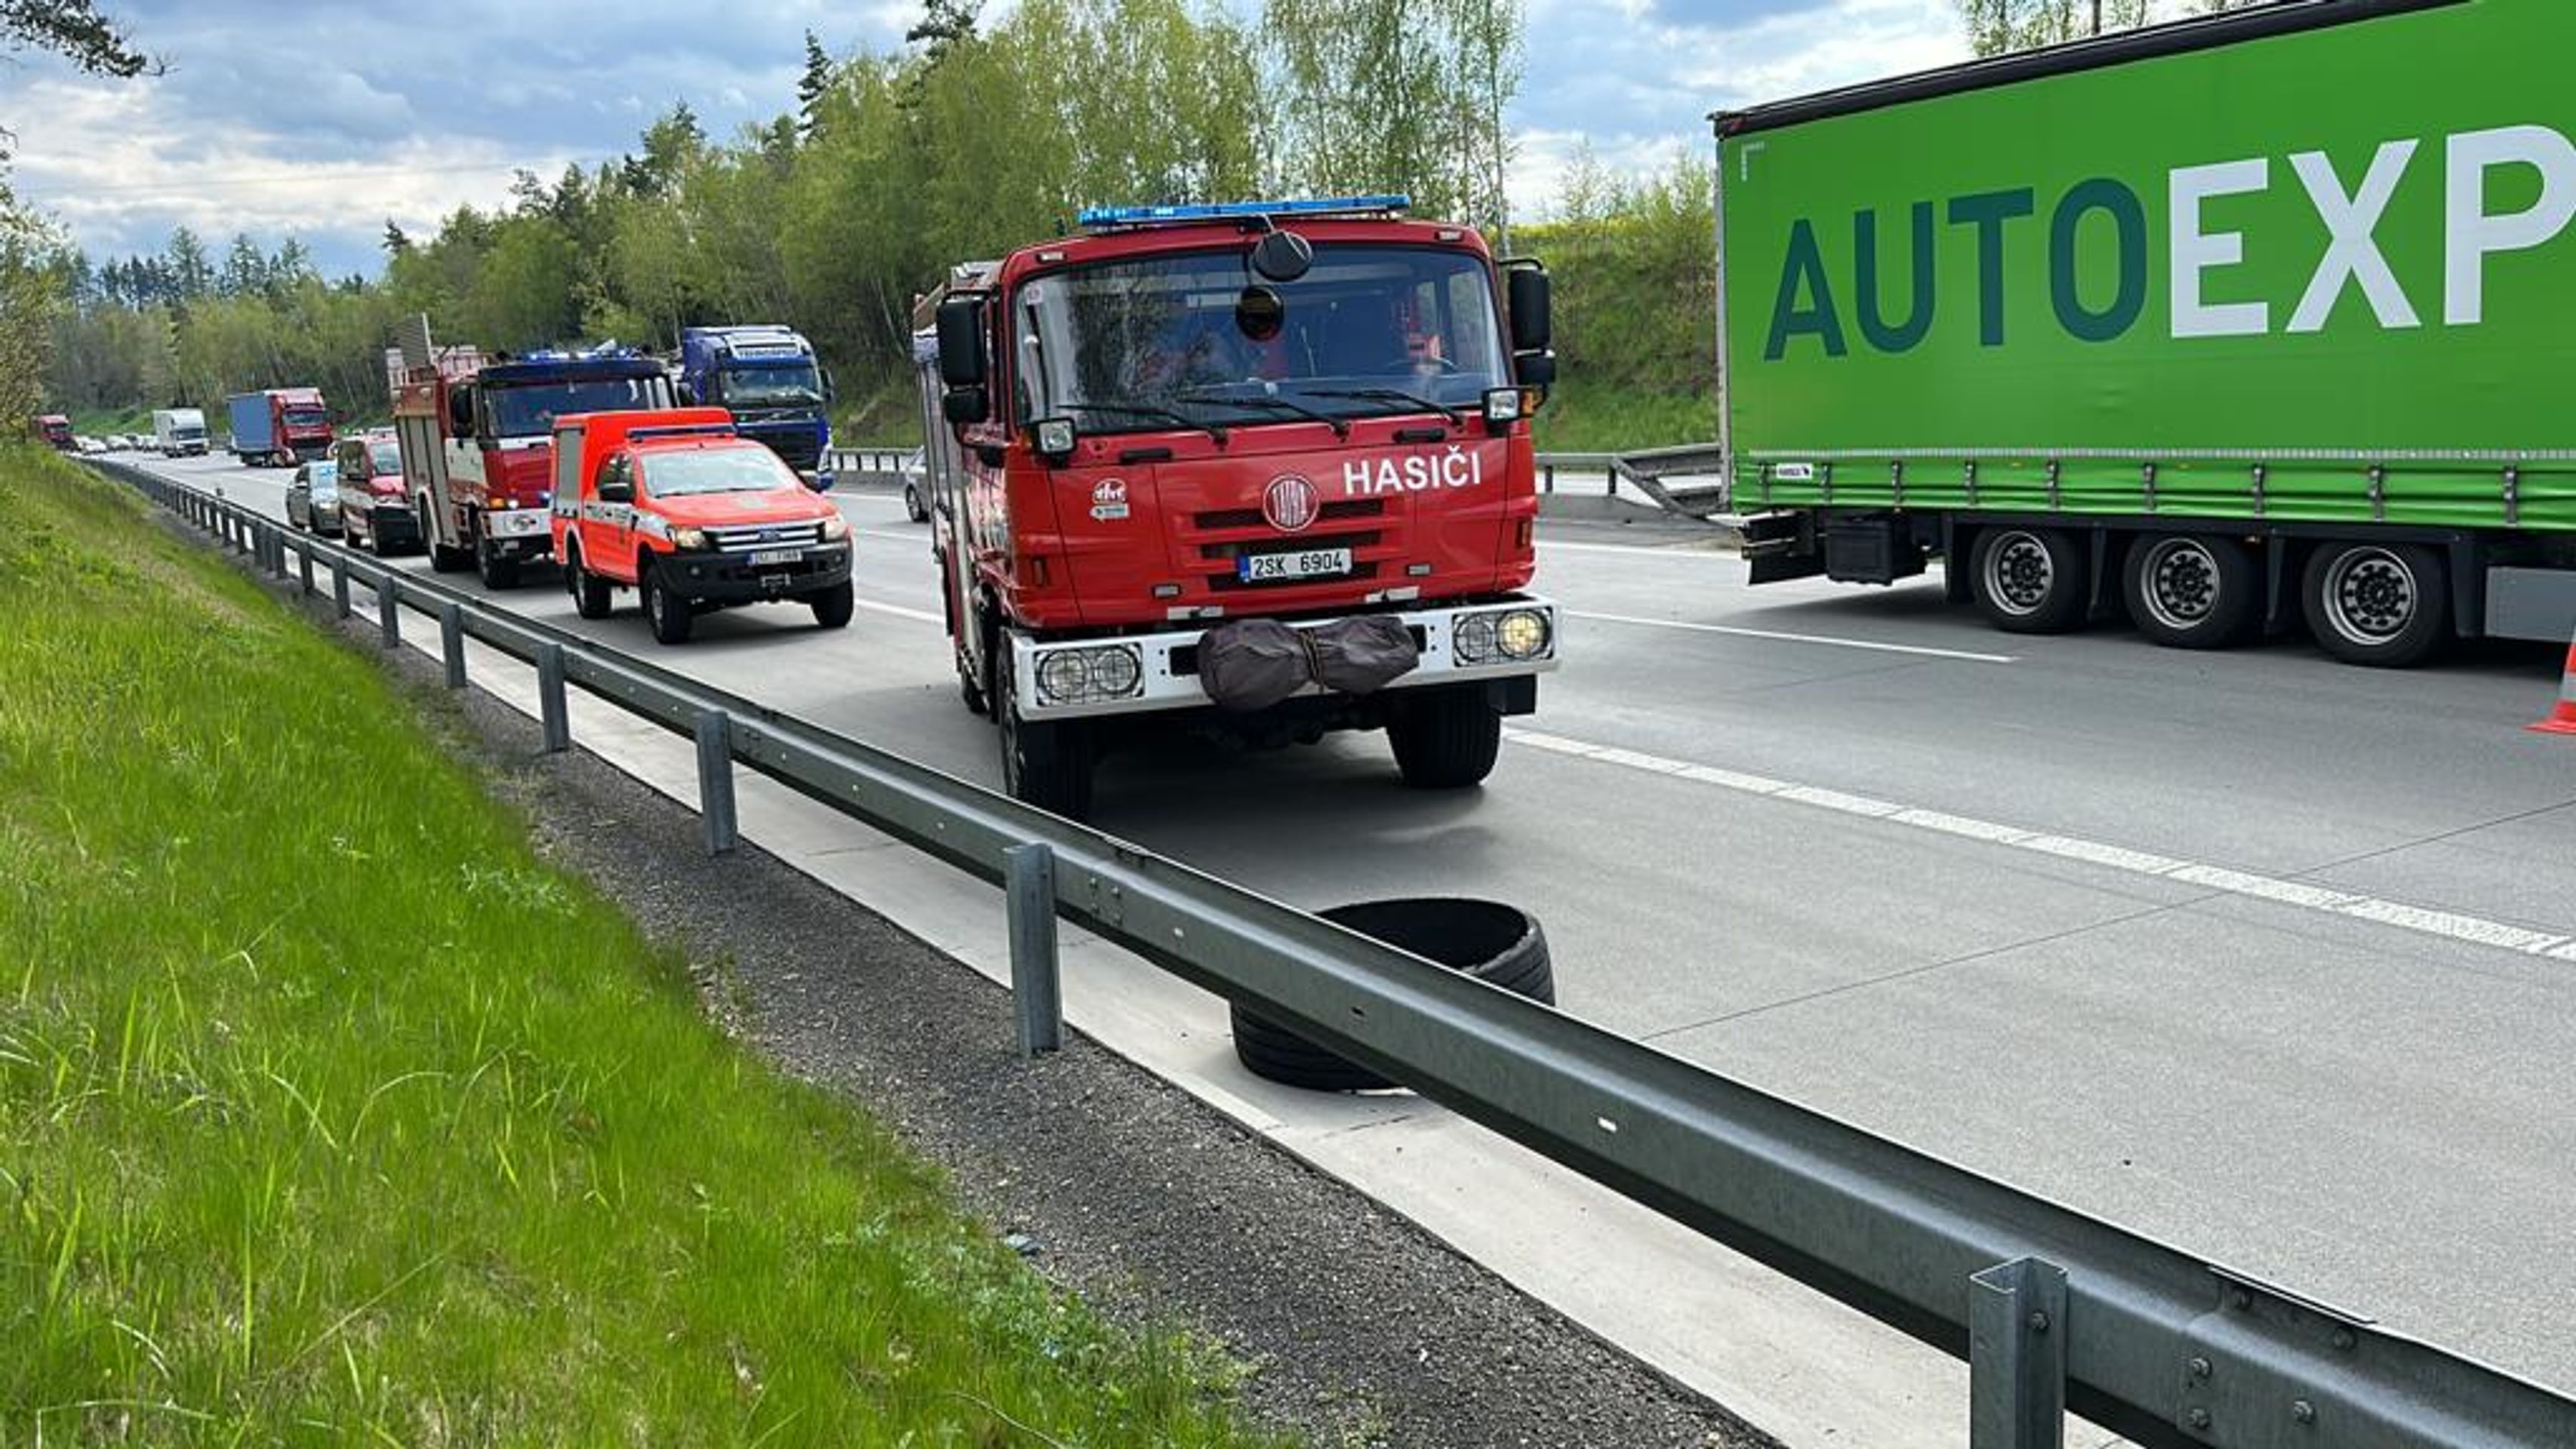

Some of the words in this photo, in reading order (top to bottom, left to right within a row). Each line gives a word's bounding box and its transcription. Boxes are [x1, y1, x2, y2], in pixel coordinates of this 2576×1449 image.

[1343, 445, 1481, 494] HASIČI
[1254, 558, 1287, 577] 2SK
[1300, 552, 1342, 572] 6904
